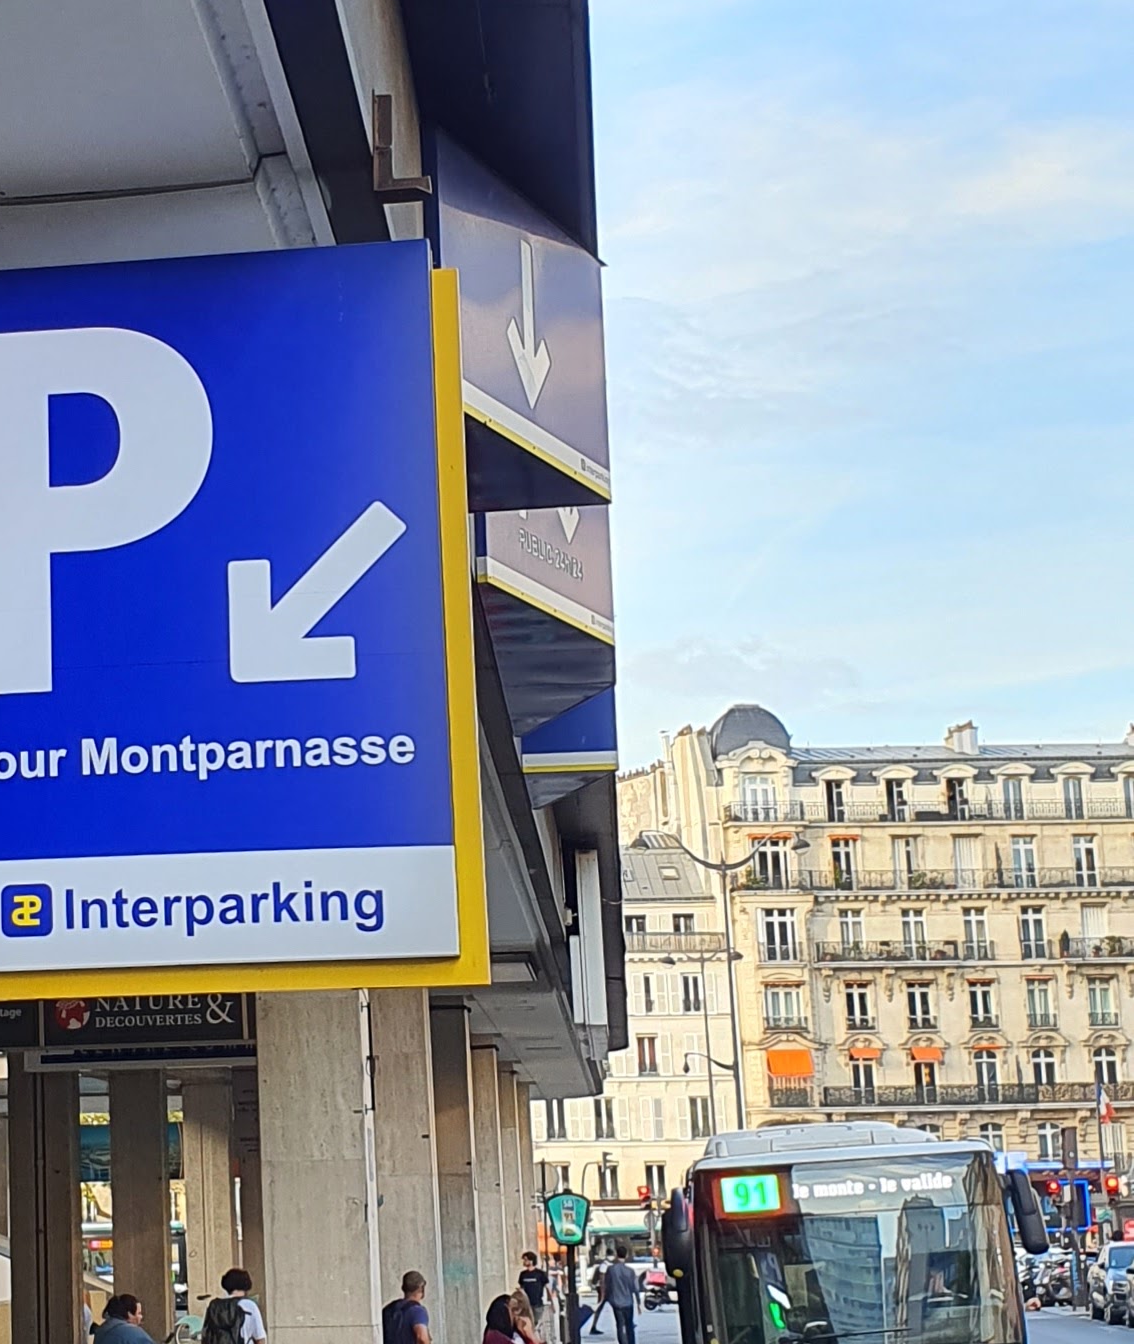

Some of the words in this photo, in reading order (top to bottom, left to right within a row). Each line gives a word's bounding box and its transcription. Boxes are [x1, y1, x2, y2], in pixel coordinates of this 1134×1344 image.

[519, 527, 554, 565] PUBLIC
[81, 733, 416, 781] Montparnasse
[66, 881, 385, 937] Interparking
[95, 1013, 202, 1028] DECOUVERTES
[733, 1181, 767, 1207] 91
[901, 1171, 953, 1192] valide
